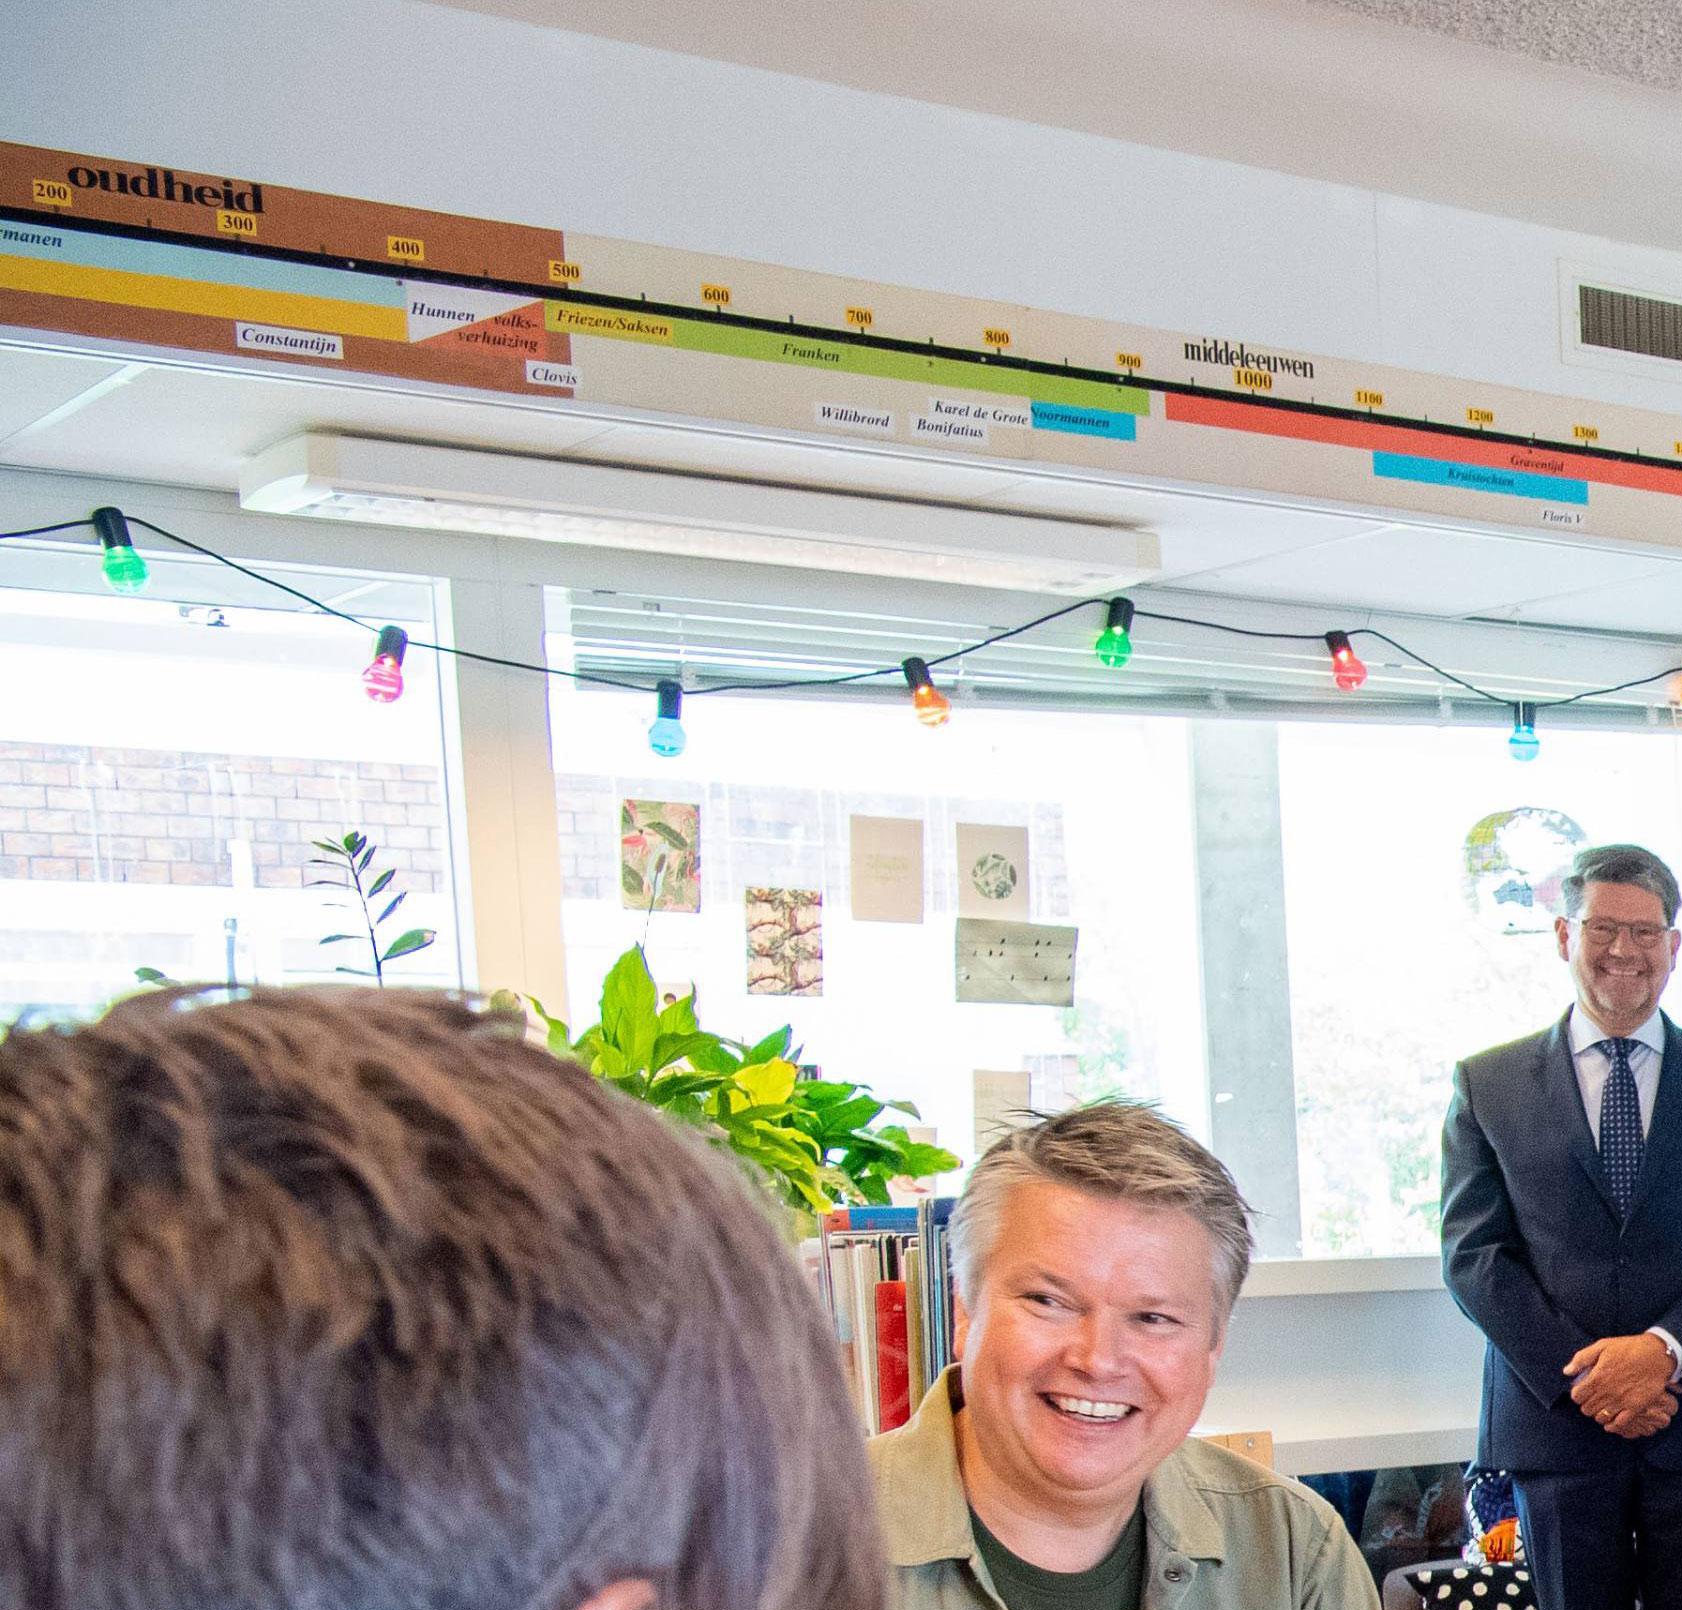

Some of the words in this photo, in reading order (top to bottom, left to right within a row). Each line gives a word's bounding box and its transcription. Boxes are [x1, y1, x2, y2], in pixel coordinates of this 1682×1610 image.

[35, 182, 68, 201] 200
[67, 166, 265, 214] oudheid
[222, 214, 254, 232] 300
[391, 239, 421, 257] 400
[551, 263, 581, 280] 500
[703, 288, 730, 303] 600
[411, 301, 476, 323] Hunnen
[846, 308, 873, 325] 700
[493, 314, 539, 330] volks-
[555, 308, 669, 337] Friezen/Saksen
[241, 327, 338, 356] Constantijn
[457, 329, 539, 353] verhuizing
[984, 330, 1011, 346] 800
[781, 342, 841, 364] Franken
[1116, 352, 1142, 370] 900
[1182, 338, 1315, 380] middeleeuwen
[531, 366, 579, 386] Clovis
[1234, 367, 1273, 391] 1000
[1355, 390, 1384, 407] 1100
[820, 406, 891, 429] Willibrord
[933, 400, 970, 419] Karel
[975, 407, 989, 421] de
[991, 409, 1030, 427] Grote
[1467, 409, 1494, 423] 1200
[916, 418, 985, 440] Bonifatius
[1572, 425, 1598, 439] 1300
[1542, 510, 1573, 525] Floris
[1575, 514, 1585, 525] V
